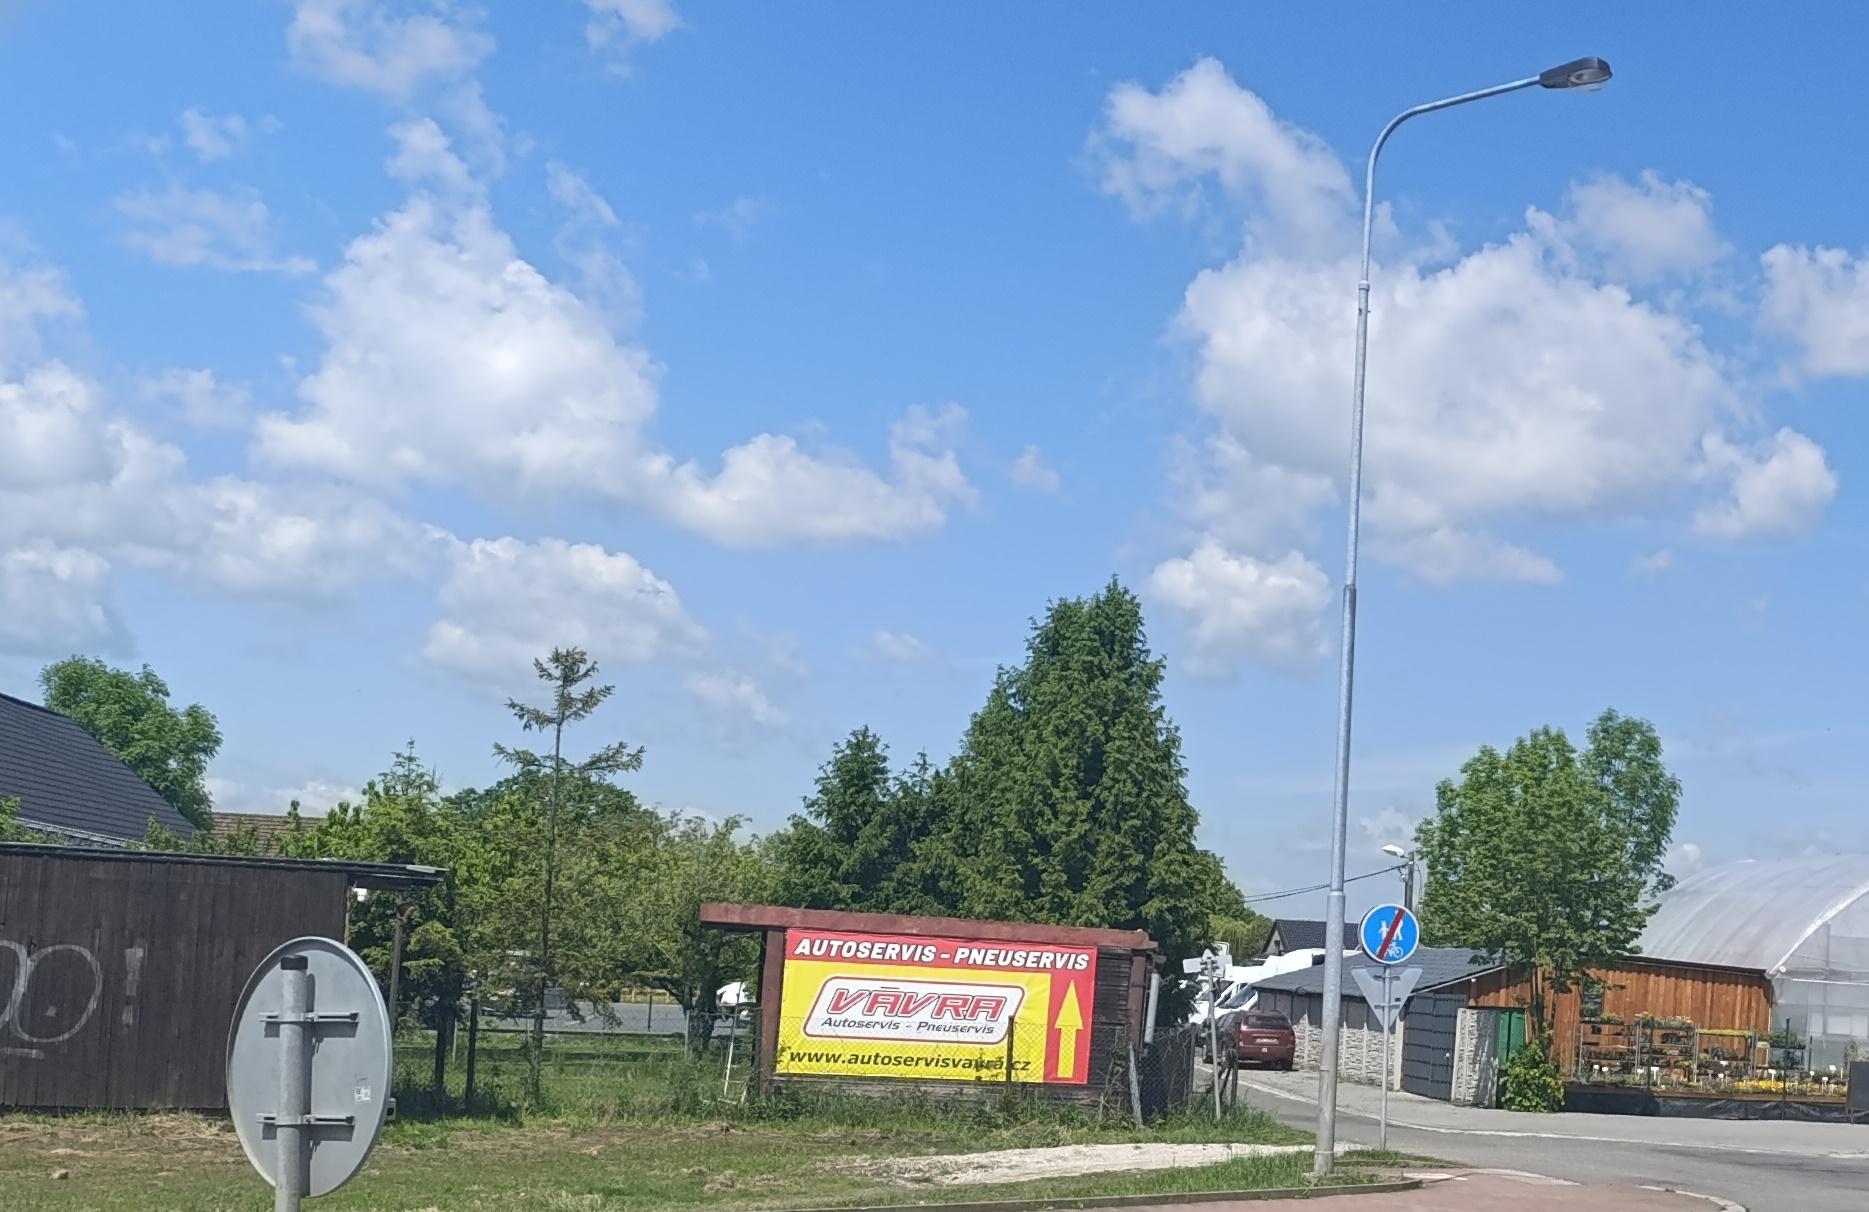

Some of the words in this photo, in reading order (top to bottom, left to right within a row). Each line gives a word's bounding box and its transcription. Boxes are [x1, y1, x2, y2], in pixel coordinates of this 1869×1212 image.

[794, 938, 937, 962] AUTOSERVIS
[953, 947, 1090, 970] PNEUSERVIS
[821, 1017, 901, 1030] Autoservis
[916, 1021, 995, 1034] Pneuservis
